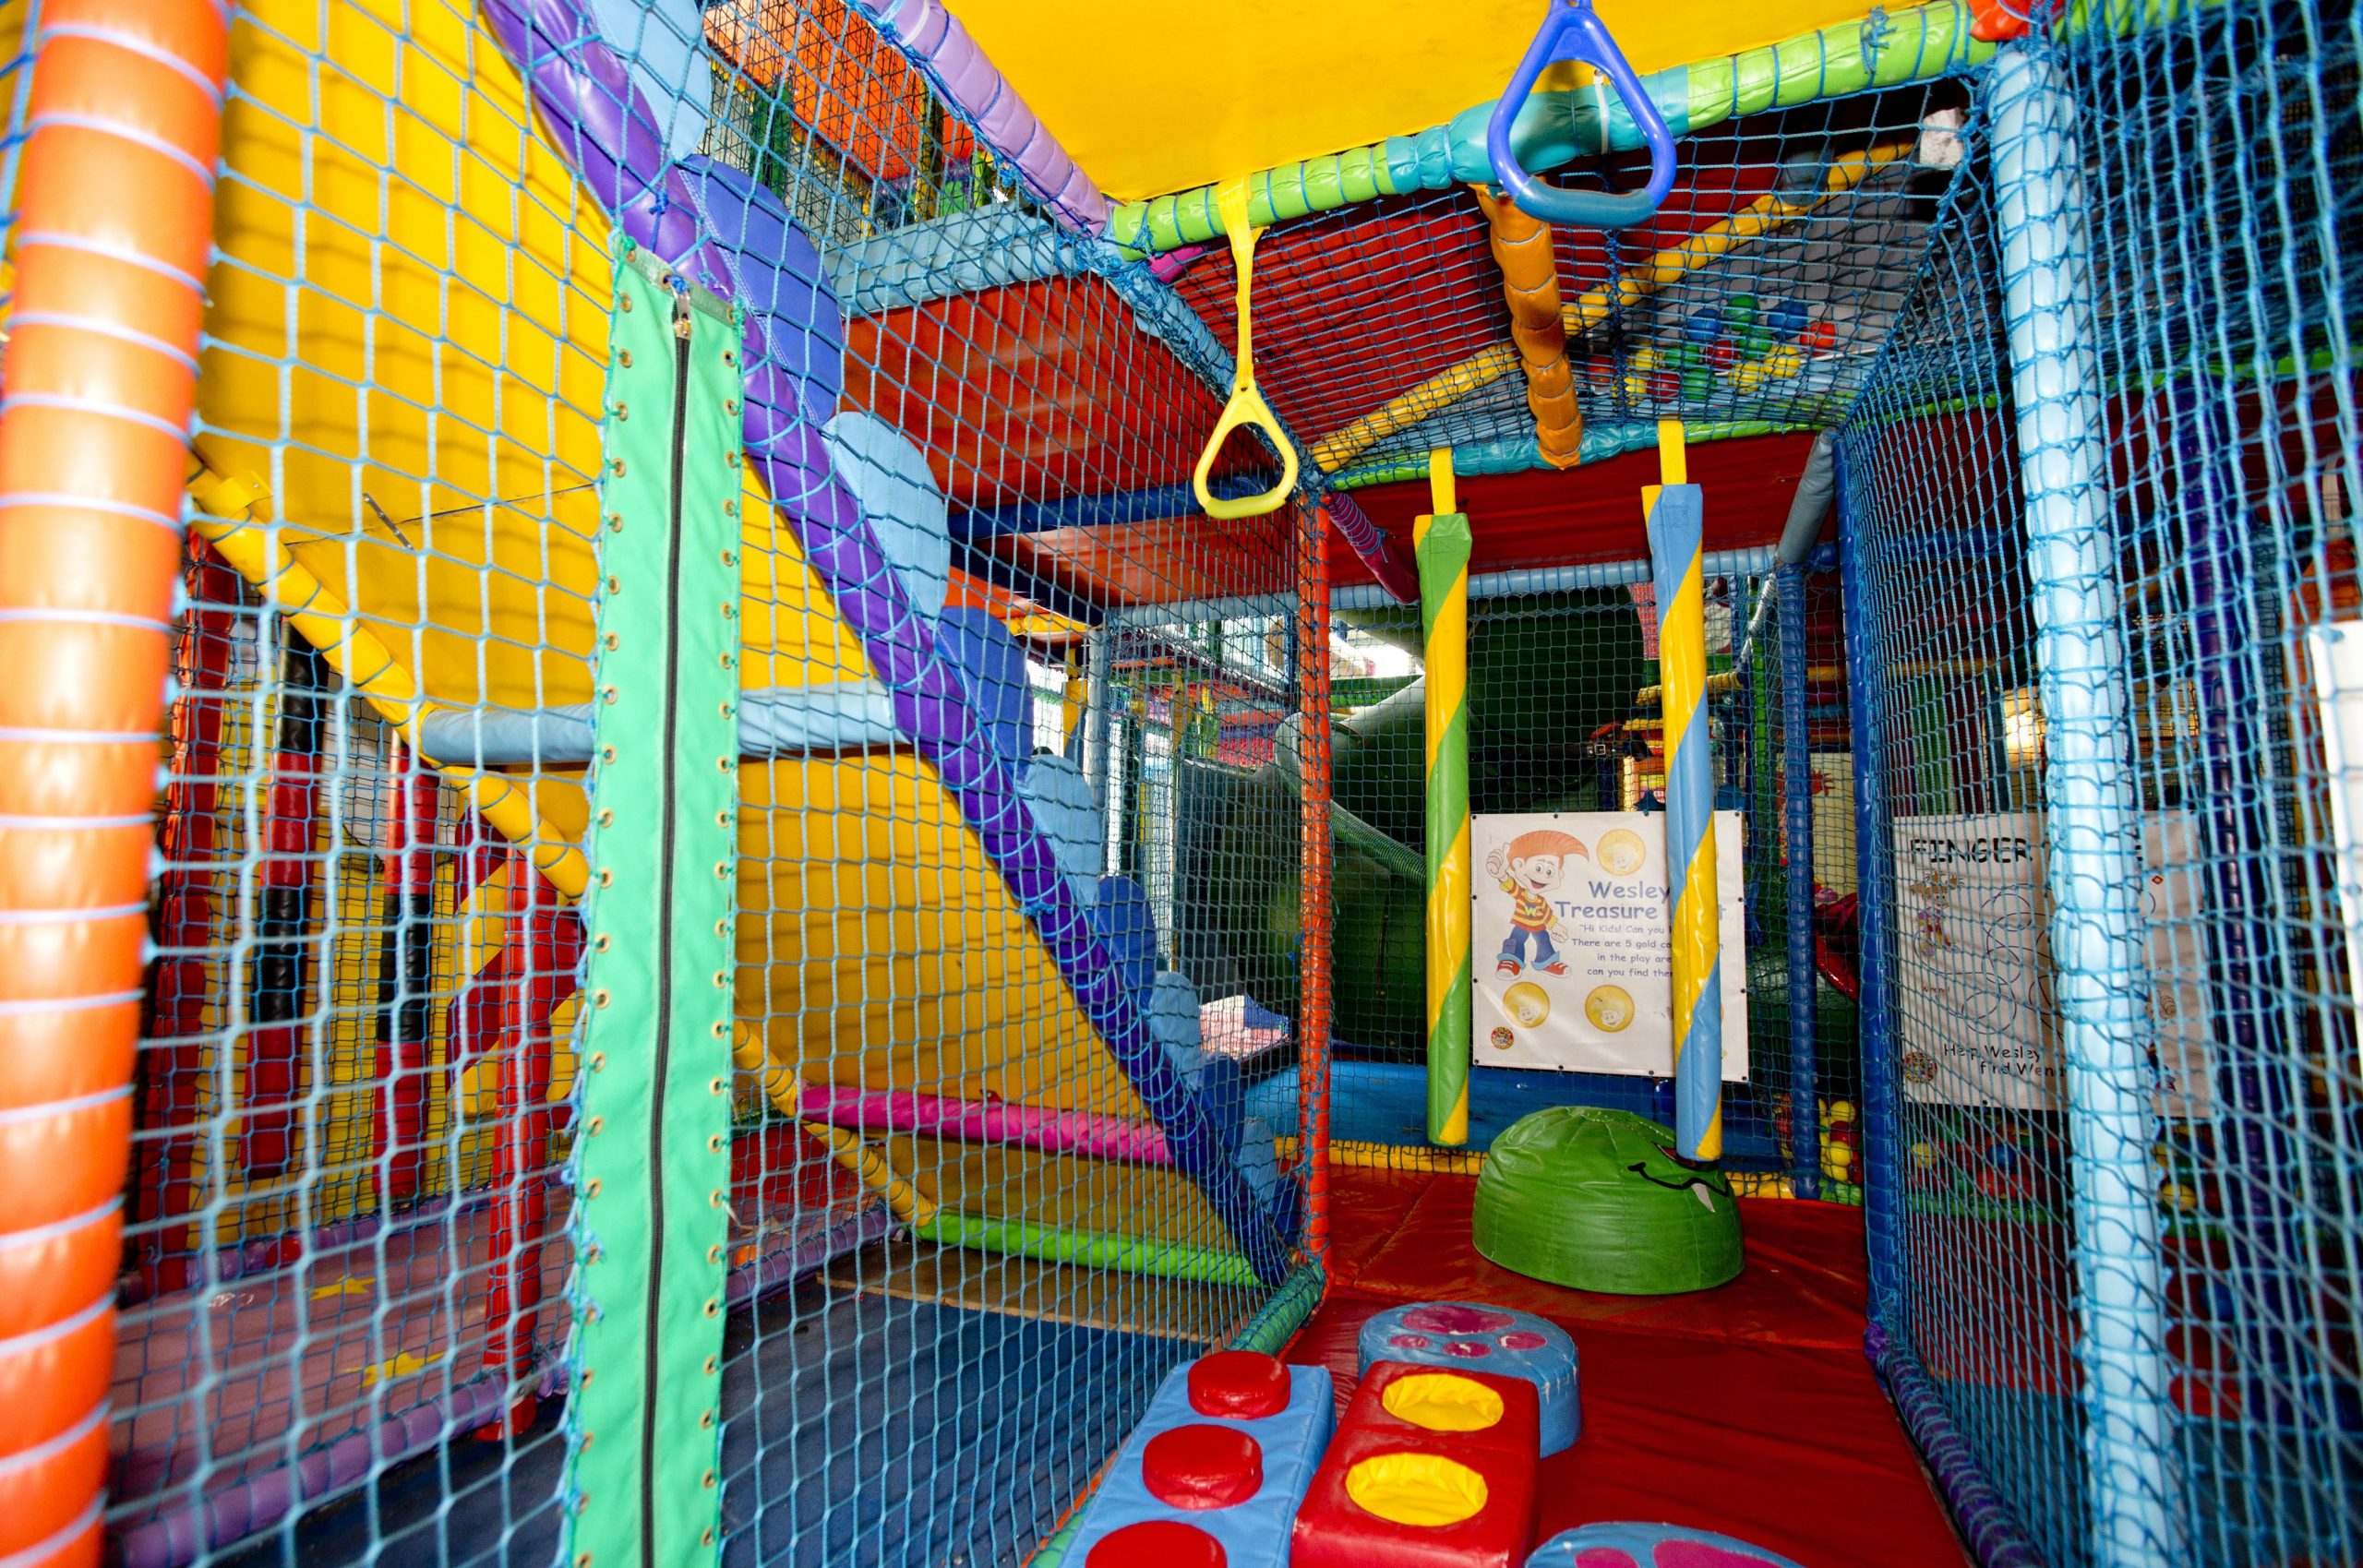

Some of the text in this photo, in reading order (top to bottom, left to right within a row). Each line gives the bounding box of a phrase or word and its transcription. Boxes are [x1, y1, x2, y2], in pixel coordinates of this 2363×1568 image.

[1910, 837, 2033, 864] FINGER
[1554, 901, 1658, 920] Treasure
[1625, 925, 1644, 934] Can
[1648, 928, 1665, 936] you
[1571, 939, 1601, 947] There
[1625, 940, 1632, 948] 5
[1636, 940, 1657, 951] gold
[1598, 953, 1606, 962] in
[1610, 954, 1627, 963] the
[1630, 954, 1651, 964] play
[1628, 968, 1649, 977] find
[1944, 1044, 2040, 1062] Hep Wesley
